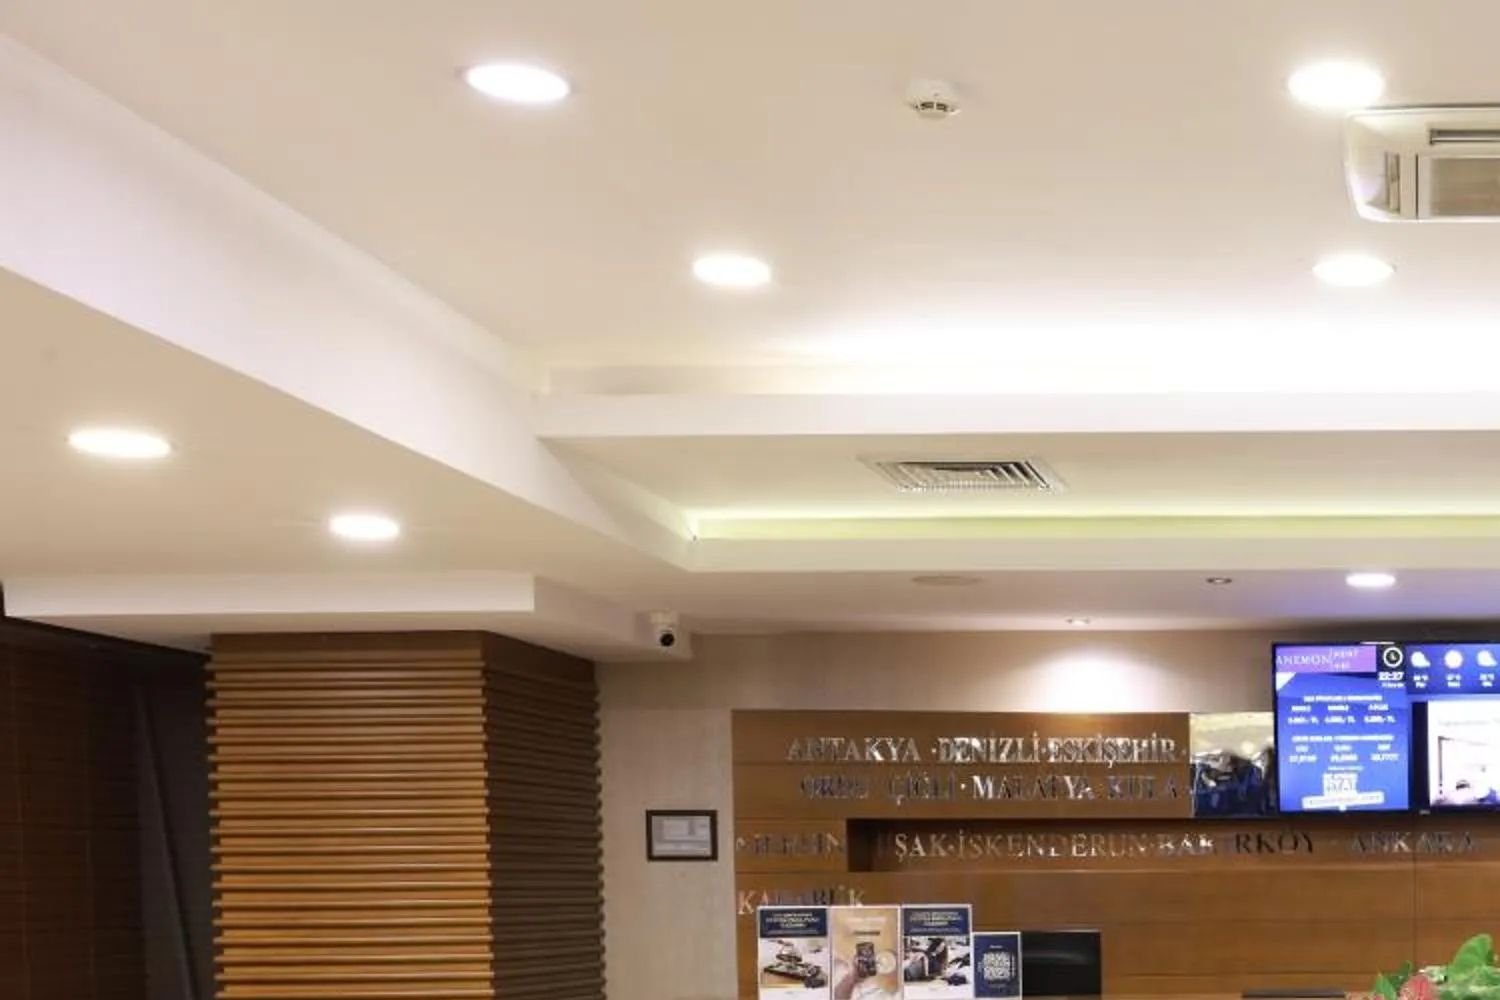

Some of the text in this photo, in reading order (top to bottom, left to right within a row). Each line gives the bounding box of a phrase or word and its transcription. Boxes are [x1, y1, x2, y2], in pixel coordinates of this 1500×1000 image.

[786, 731, 1178, 768] ANTAKYA DENİZLİ ESKİŞEHİR
